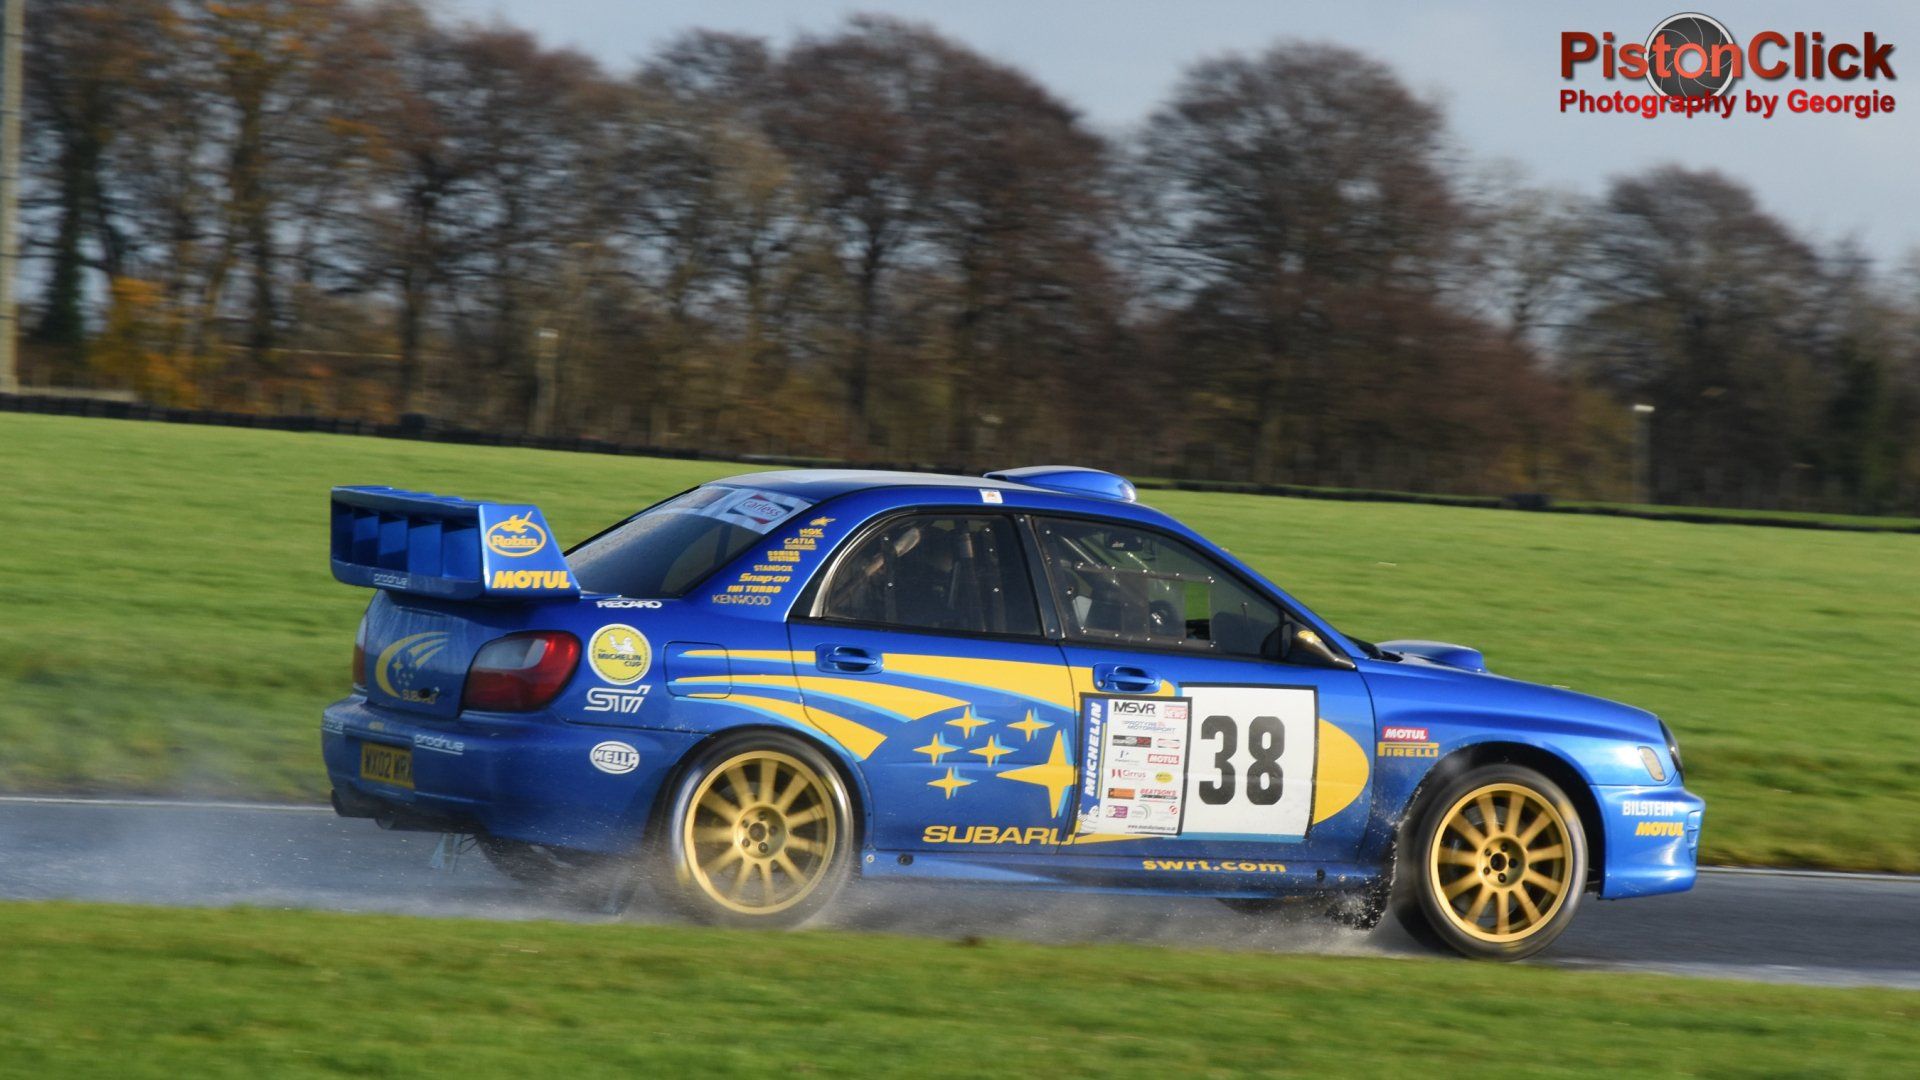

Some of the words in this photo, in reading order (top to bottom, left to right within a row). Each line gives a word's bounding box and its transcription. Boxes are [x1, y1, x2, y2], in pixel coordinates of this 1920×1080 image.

[491, 534, 539, 548] Robin
[492, 570, 571, 589] MOTUL
[739, 573, 790, 583] Snap-on
[746, 585, 782, 593] TURBO
[596, 600, 663, 609] RECARO
[712, 595, 771, 605] KENWOOD
[1114, 701, 1156, 714] MSVR
[1384, 728, 1427, 740] MOTUL
[1084, 702, 1102, 797] MICHELIN
[1377, 741, 1440, 758] PIRELLI
[594, 749, 640, 769] HELLA
[1149, 755, 1178, 763] MOTUL
[1198, 715, 1286, 806] 38
[1122, 769, 1146, 778] Cirrus
[1622, 801, 1674, 816] BILSTEIN
[922, 825, 1076, 846] SUBARU
[1635, 822, 1685, 836] MOTUL
[1142, 858, 1286, 873] swrt.com
